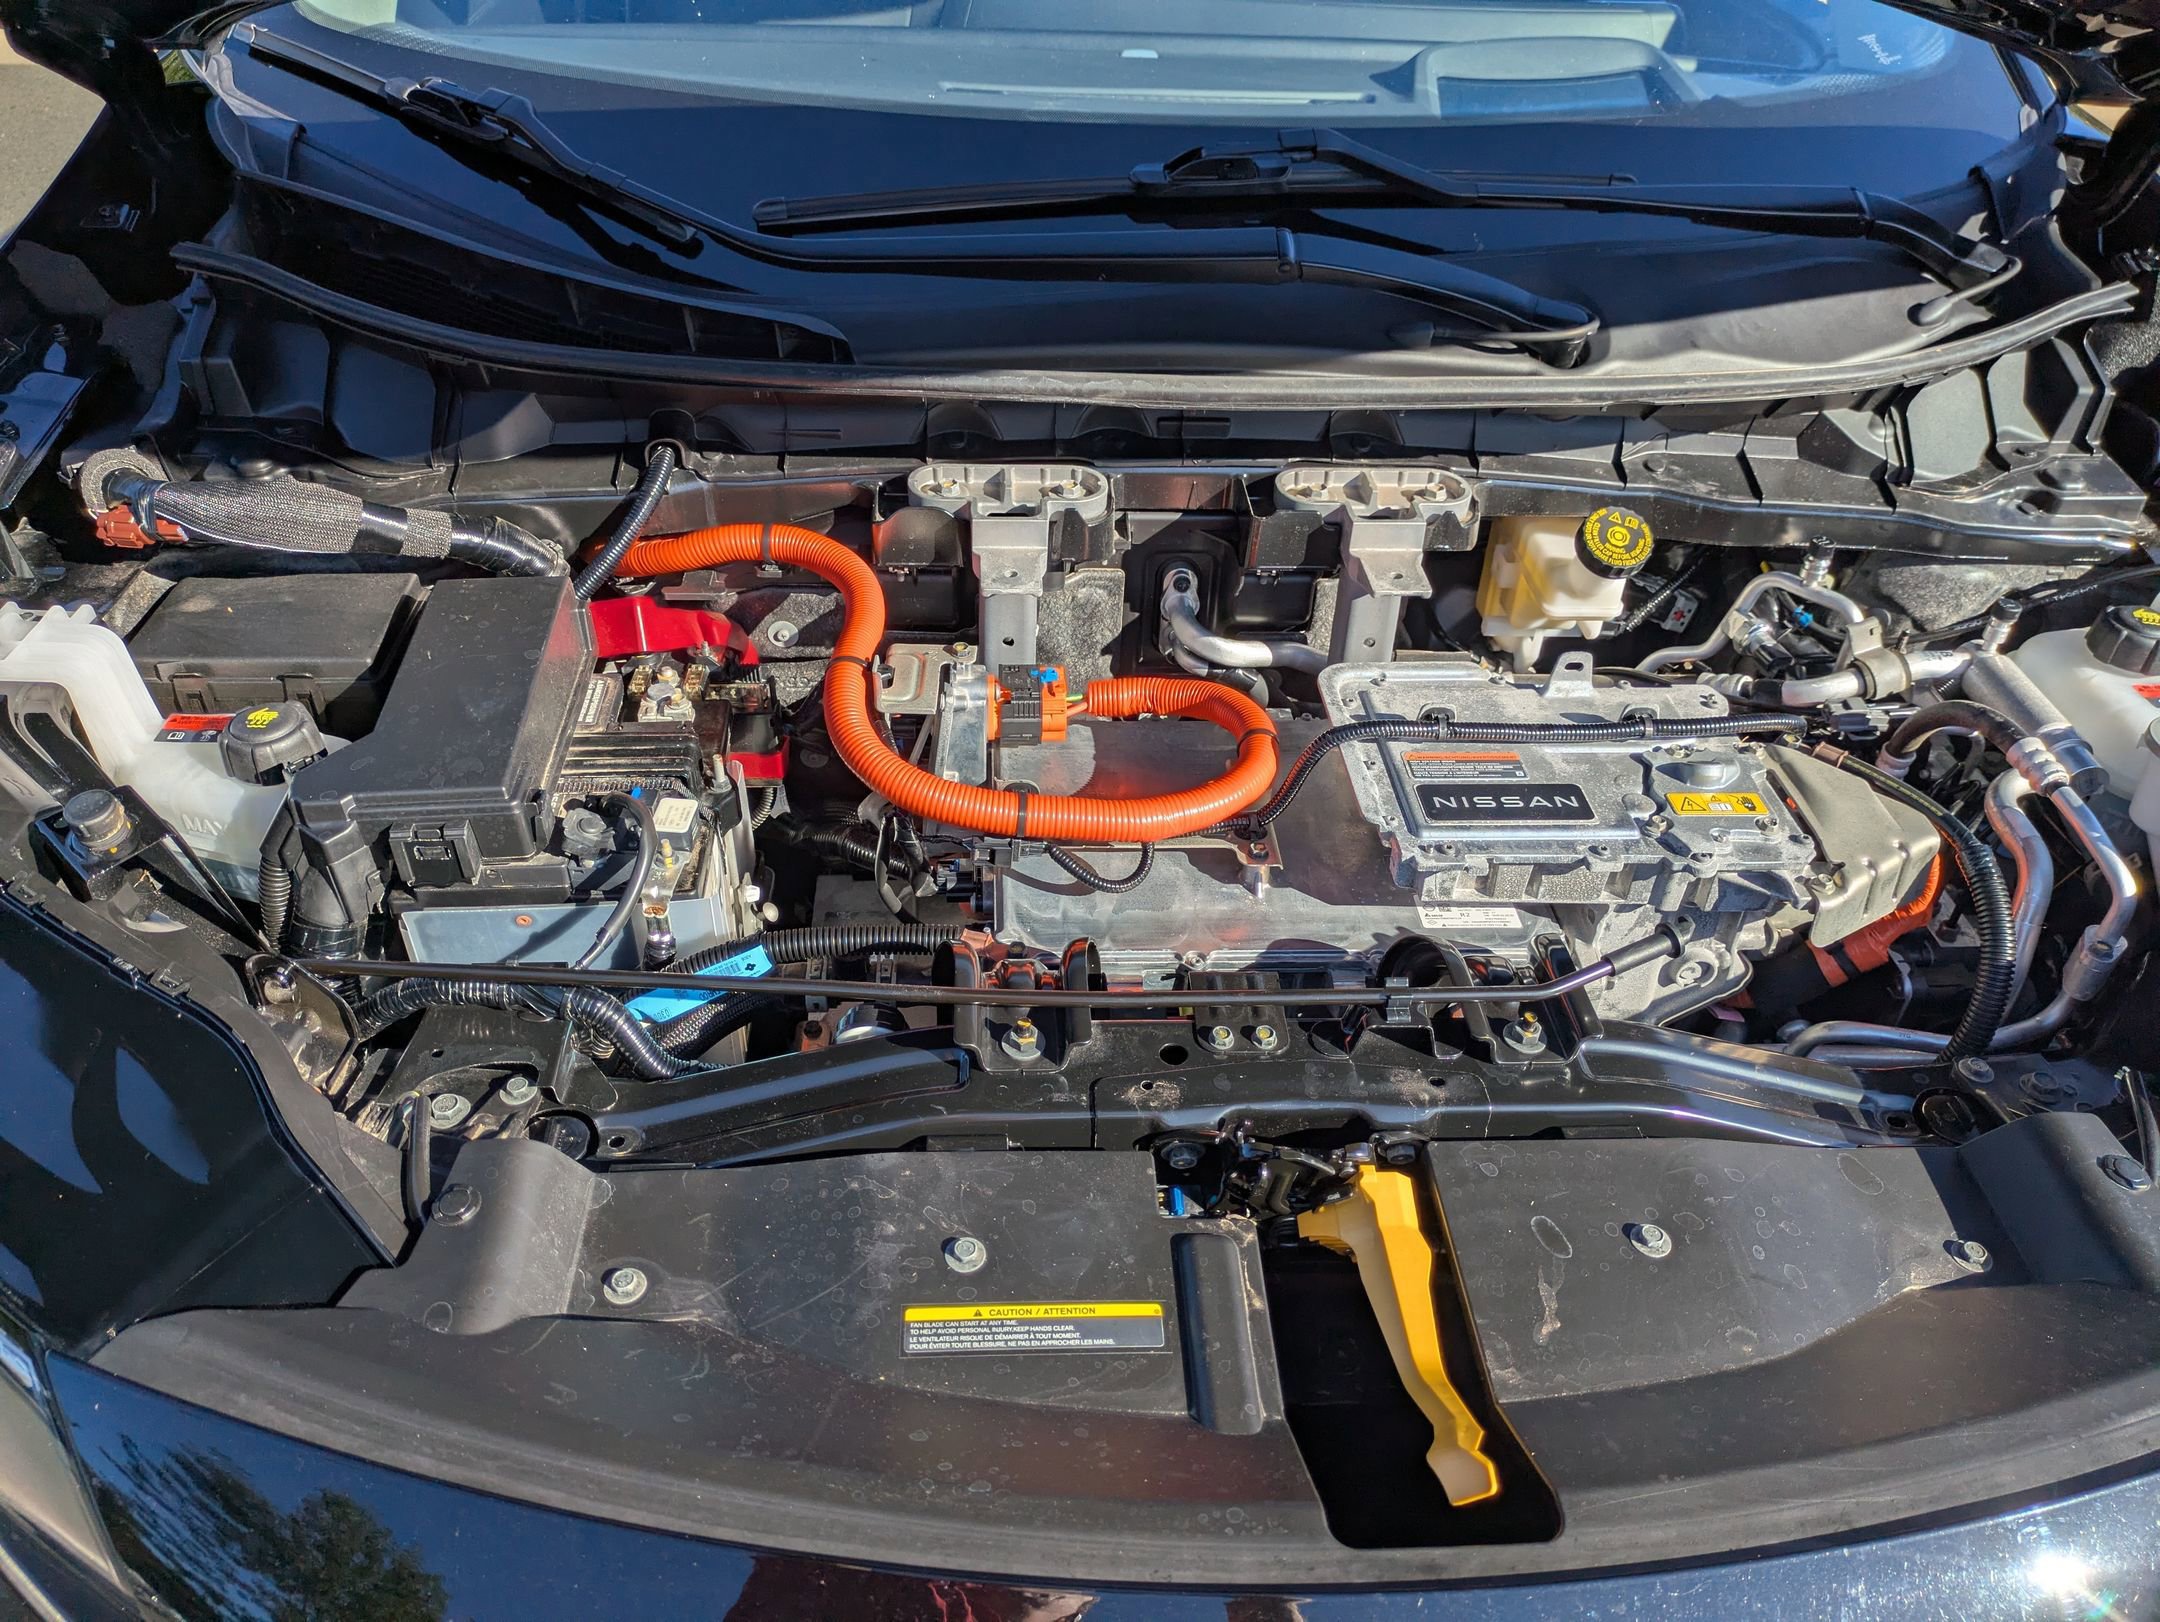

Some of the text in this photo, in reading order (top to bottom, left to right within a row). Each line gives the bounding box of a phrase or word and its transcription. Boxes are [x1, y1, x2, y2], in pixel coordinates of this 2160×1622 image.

[1602, 548, 1613, 556] CAP
[1432, 796, 1579, 808] NISSAN
[989, 1308, 1032, 1316] CAUTION
[1043, 1307, 1096, 1315] ATTENTION
